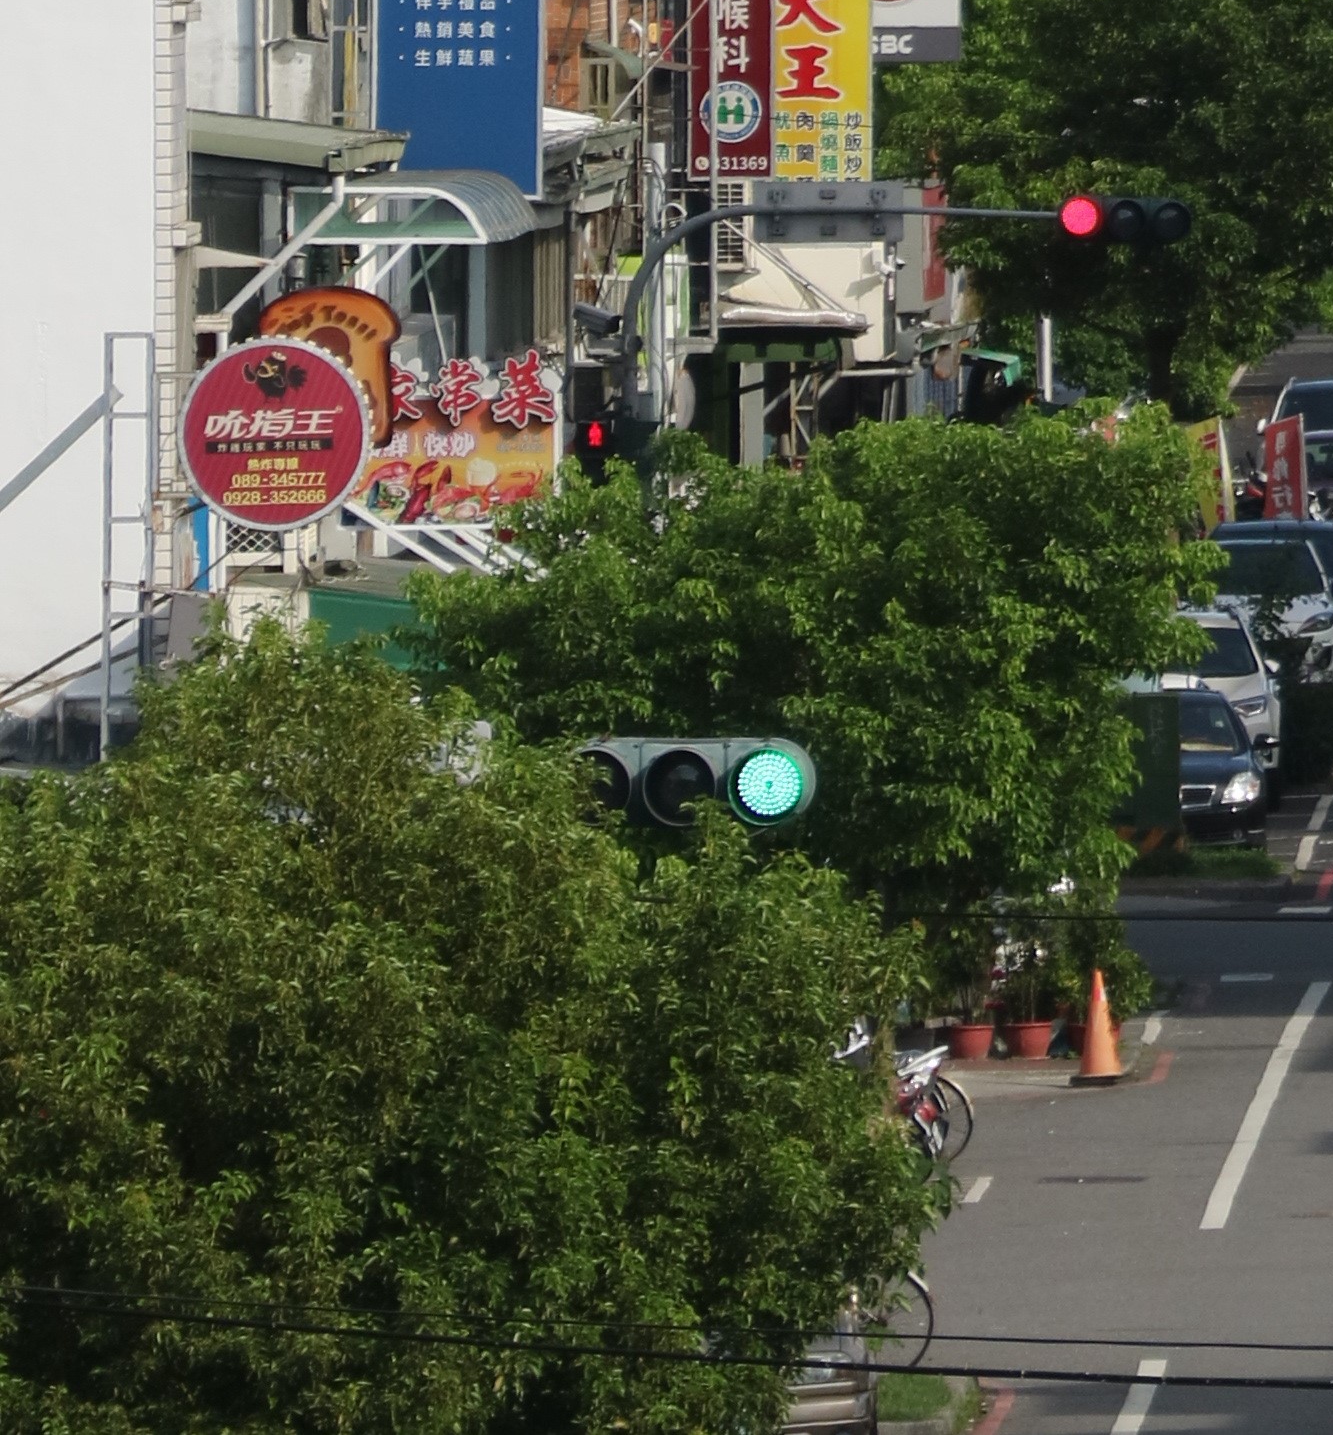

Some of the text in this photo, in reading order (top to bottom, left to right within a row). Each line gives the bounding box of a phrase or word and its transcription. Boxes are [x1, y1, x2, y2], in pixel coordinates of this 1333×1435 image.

[414, 20, 497, 40] 熱銷美食
[414, 48, 497, 67] 生鮮蔬果
[231, 471, 326, 488] 089-345777
[222, 489, 327, 506] 0928-352666
